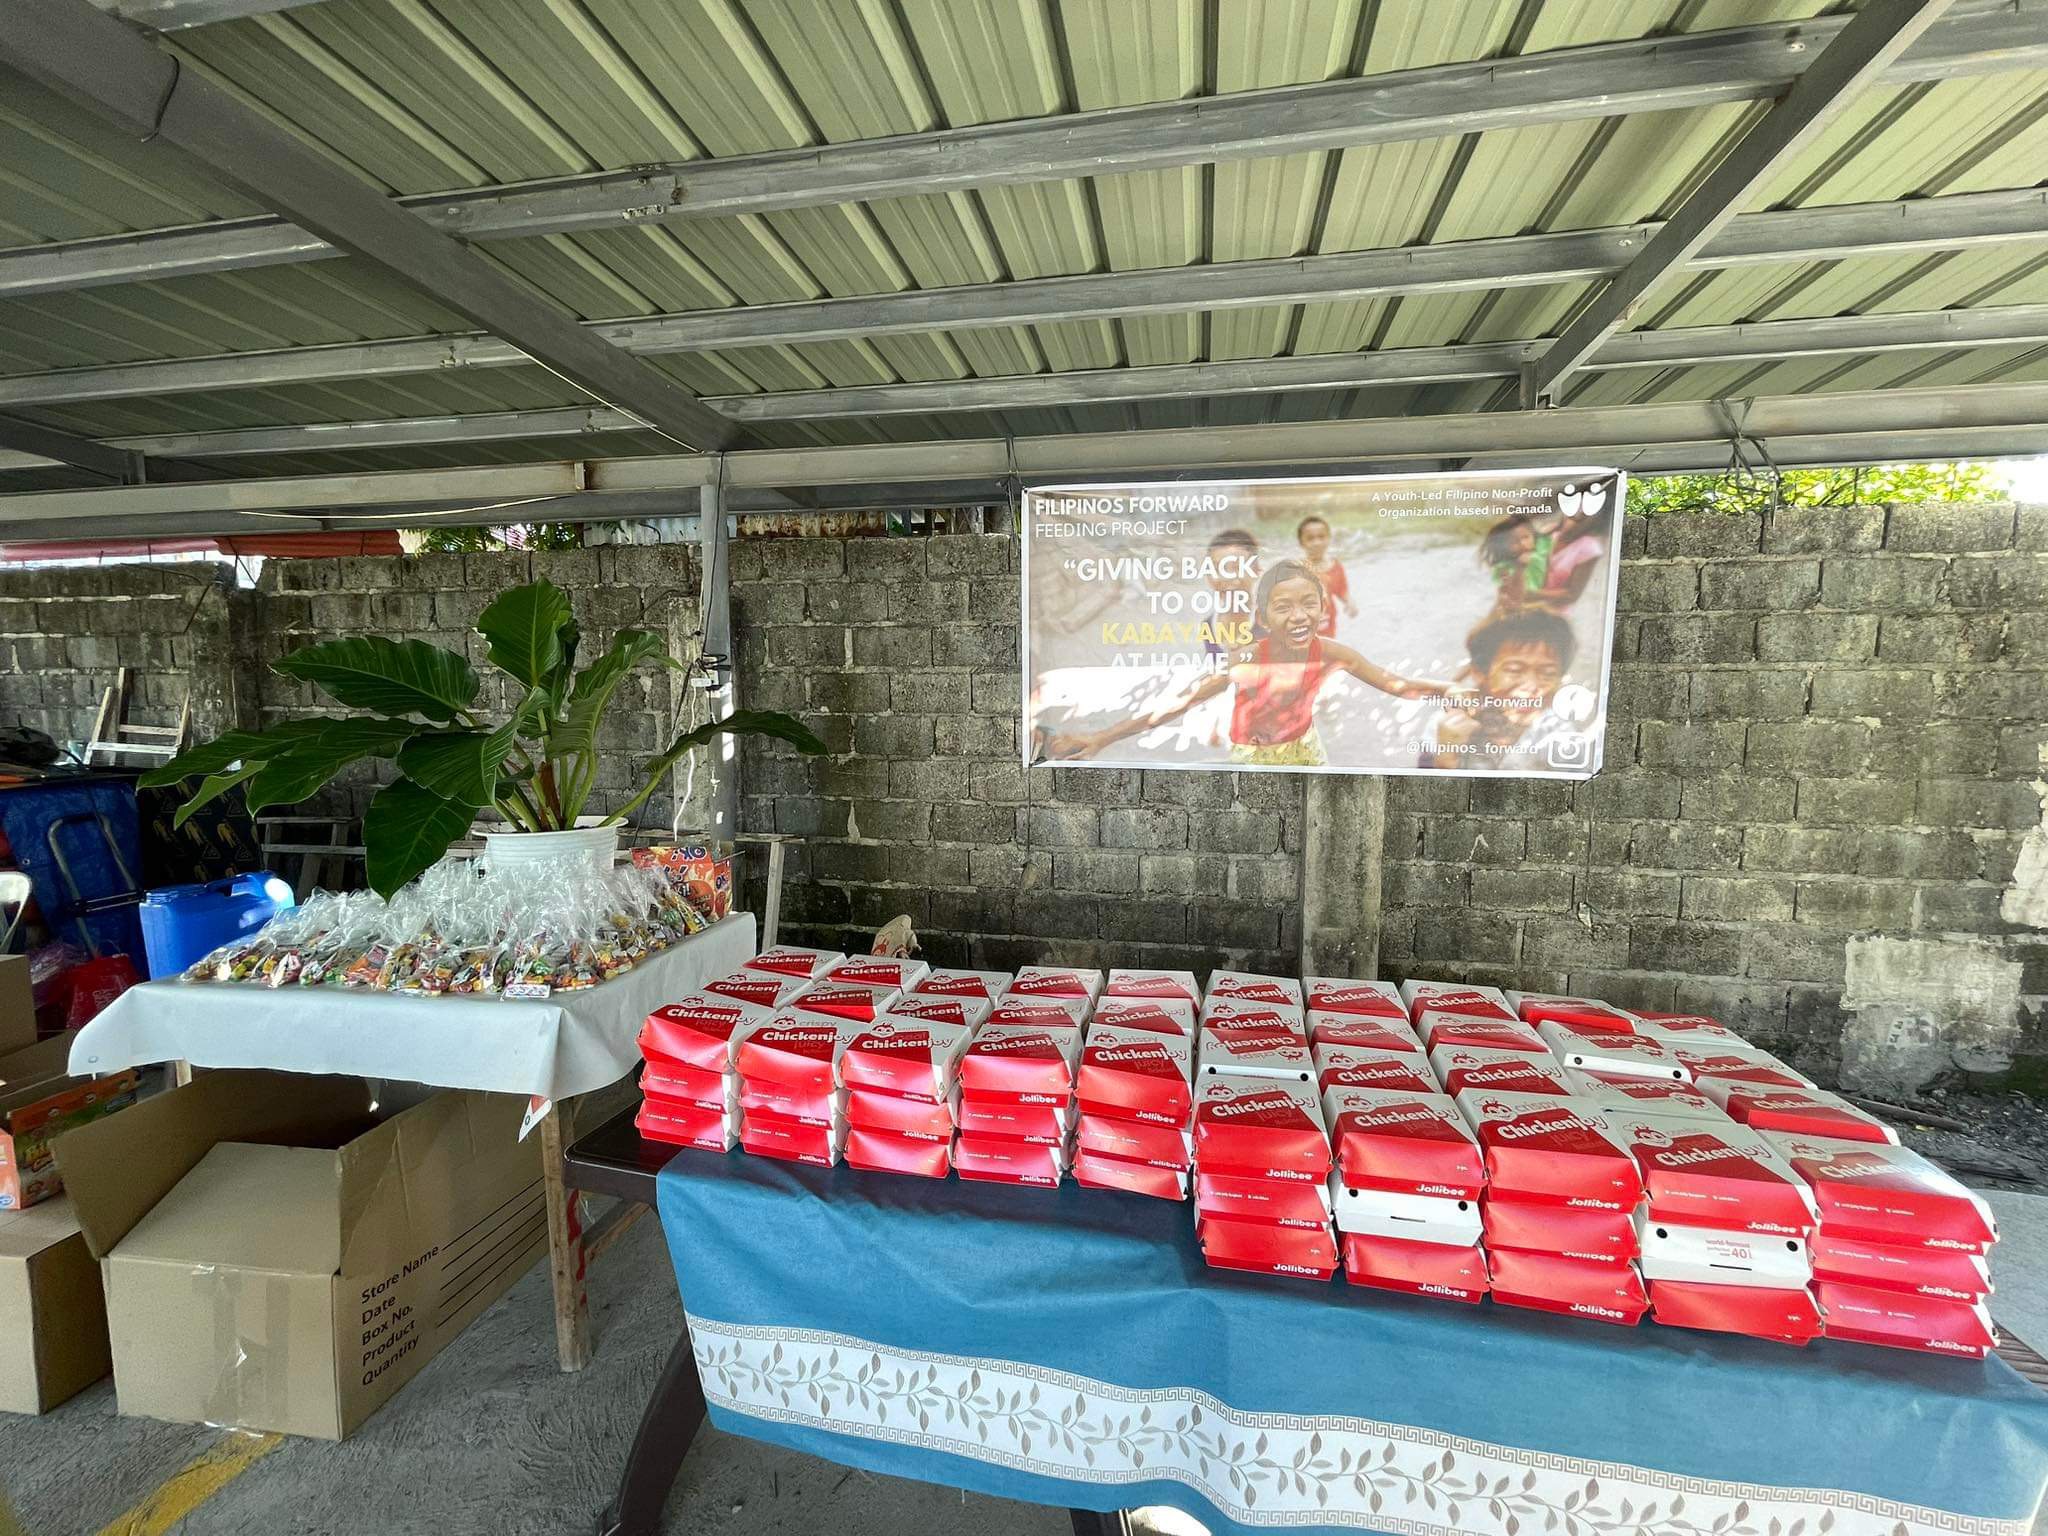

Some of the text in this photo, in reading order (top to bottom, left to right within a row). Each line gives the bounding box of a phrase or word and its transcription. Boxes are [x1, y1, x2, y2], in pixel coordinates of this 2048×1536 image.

[1372, 487, 1553, 502] A Youth-Led Filipino Non-Profit
[1035, 494, 1229, 516] FILIPINOS FORWARD
[1378, 503, 1553, 519] Organization based in Canada
[1035, 520, 1188, 538] FEEDING PROJECT
[1063, 555, 1260, 582] “GIVING BACK
[1146, 590, 1250, 614] TO OUR
[1102, 621, 1254, 645] KABAYANS
[1111, 653, 1144, 672] AT
[1420, 695, 1543, 709] Filipinos Forward
[1406, 741, 1538, 756] @filipinos_forward
[666, 1007, 758, 1026] Chickenjoy
[1217, 1015, 1301, 1031] Chickenjoy
[762, 1030, 856, 1045] Chickenjoy
[861, 1039, 955, 1050] Chickenjoy
[979, 1036, 1072, 1052] Chickenjoy
[1094, 1047, 1188, 1062] Chickenjoy
[1337, 1064, 1431, 1083] Chickenjoy
[1463, 1064, 1562, 1084] Chickenjoy
[1018, 1093, 1057, 1105] Jollibee
[1211, 1093, 1316, 1118] Chickenjoy
[1135, 1109, 1177, 1124] Jollibee
[1353, 1105, 1460, 1128] Chickenjoy
[1496, 1113, 1609, 1140] Chickenjoy
[902, 1129, 940, 1142] Jollibee
[1655, 1142, 1773, 1168] Chickenjoy
[1265, 1168, 1313, 1181] Jollibee
[1415, 1183, 1467, 1197] Jollibee
[1565, 1197, 1621, 1211] Jollibee
[1277, 1217, 1318, 1229] Jollibee
[1746, 1221, 1798, 1234] Jollibee
[1923, 1238, 1977, 1251] Jollibee
[361, 1246, 440, 1304] Store Name
[1272, 1263, 1320, 1275] Jollibee
[1416, 1282, 1468, 1298] Jollibee
[1916, 1284, 1972, 1300] Jollibee
[362, 1295, 396, 1326] Date
[1569, 1302, 1625, 1319] Jollibee
[362, 1305, 414, 1346] Box No.
[362, 1319, 416, 1367] Product
[1924, 1338, 1978, 1353] Jollibee
[362, 1335, 420, 1386] Quantity
